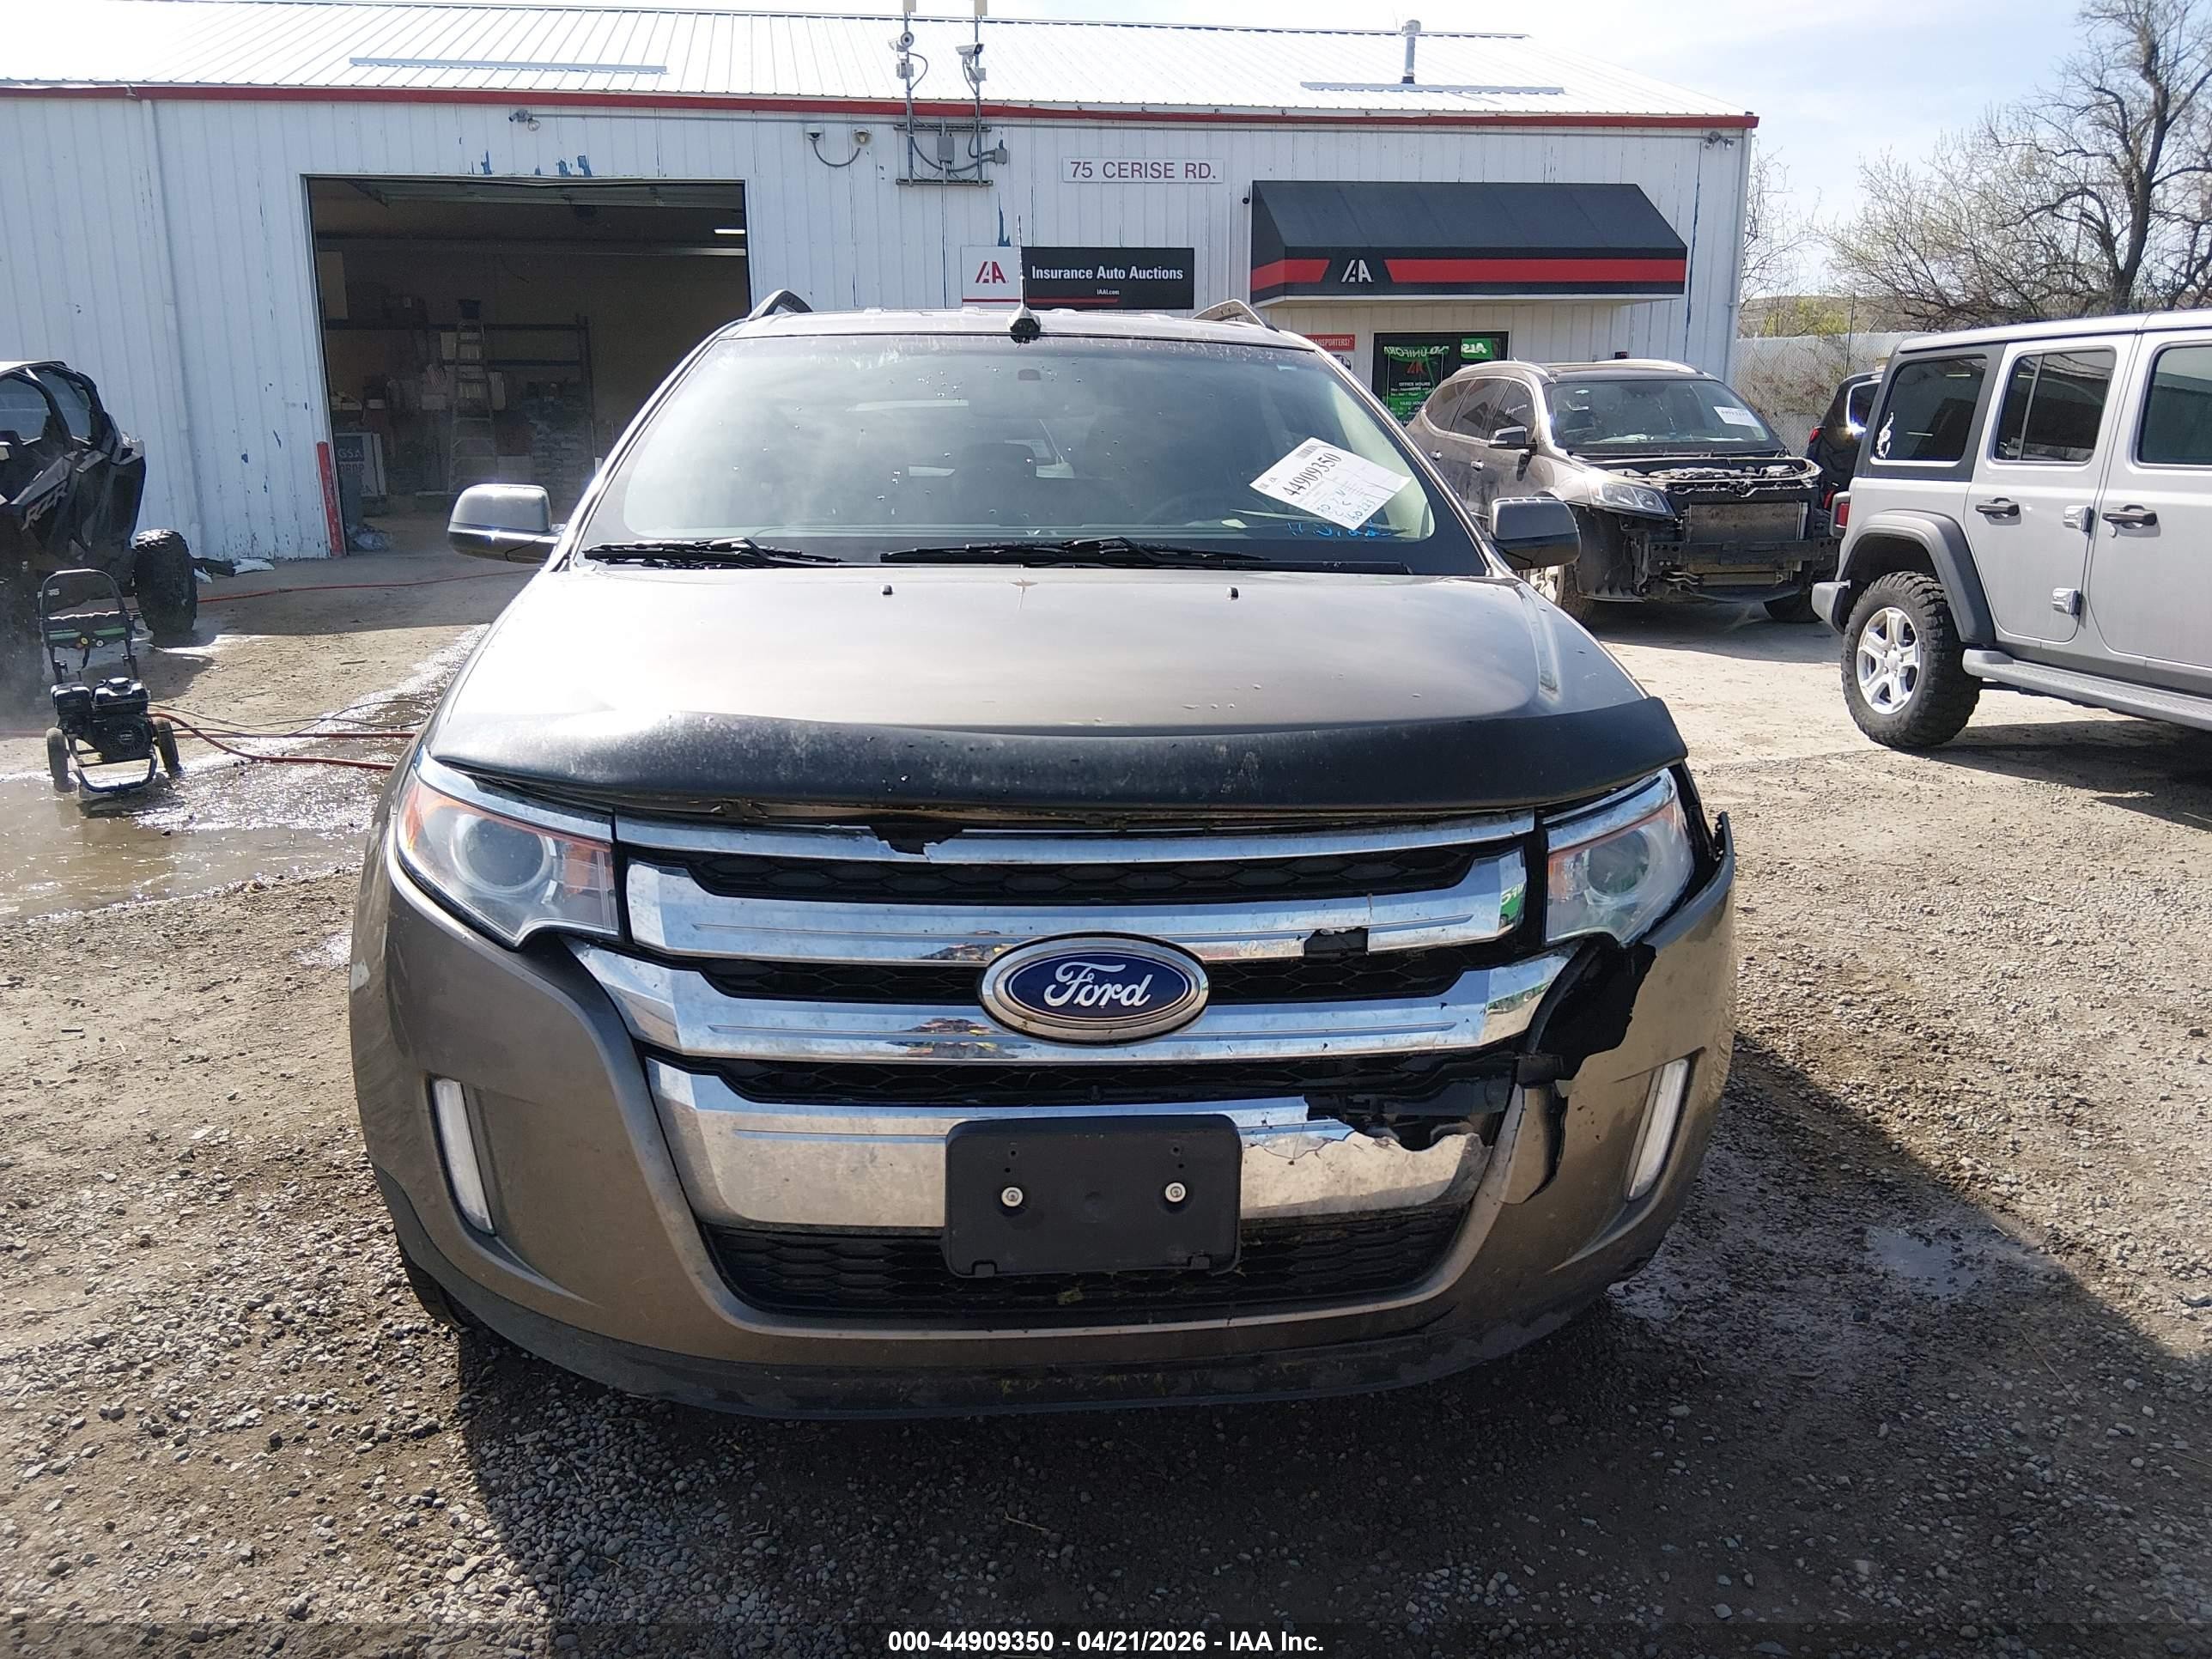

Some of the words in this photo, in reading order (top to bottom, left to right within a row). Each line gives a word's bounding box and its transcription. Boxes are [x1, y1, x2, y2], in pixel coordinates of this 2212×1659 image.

[1070, 161, 1093, 179] 75
[1103, 161, 1176, 179] CERISE
[1185, 162, 1216, 179] RD.
[1031, 265, 1093, 280] Insurance
[1097, 265, 1126, 280] Auto
[1129, 265, 1183, 280] Auctions
[1281, 453, 1342, 497] 44909350
[1043, 961, 1153, 1007] Ford
